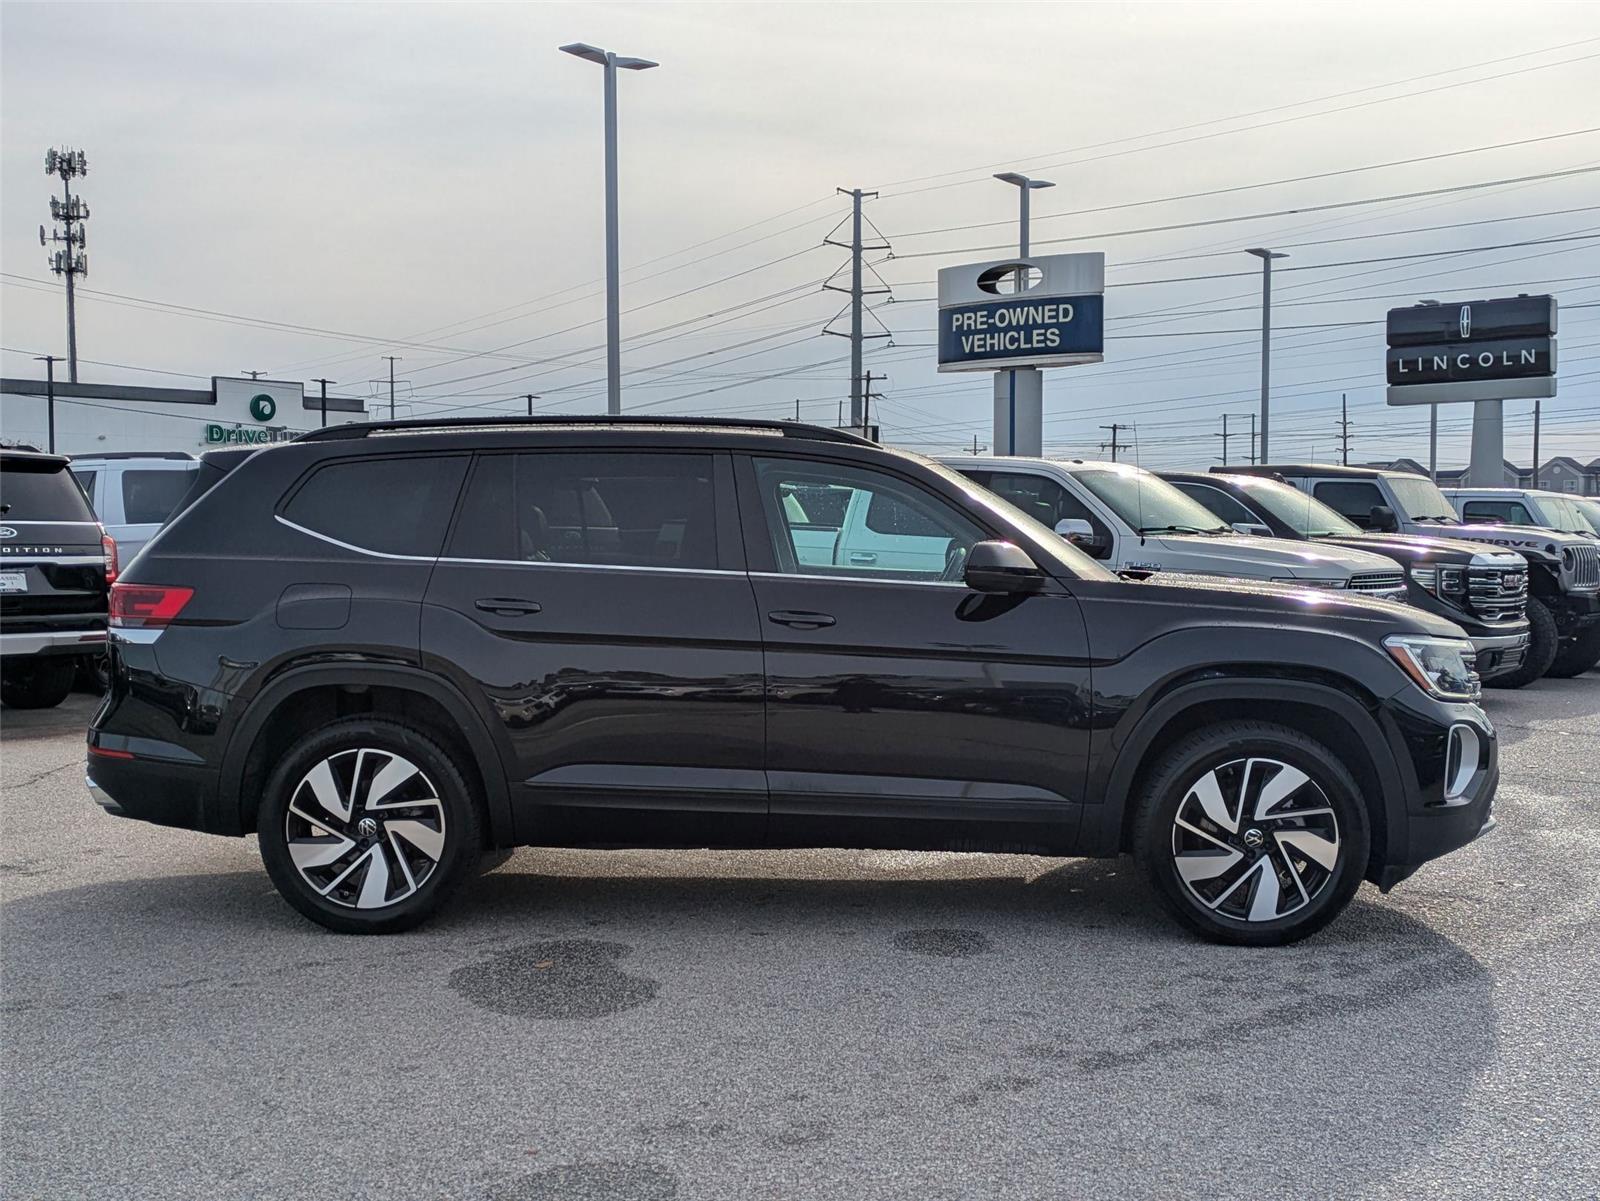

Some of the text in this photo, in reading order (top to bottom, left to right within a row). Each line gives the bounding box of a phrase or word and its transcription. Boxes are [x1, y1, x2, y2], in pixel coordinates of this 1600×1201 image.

[952, 304, 1074, 332] PRE-OWNED
[962, 328, 1060, 353] VEHICLES
[1399, 349, 1536, 373] LINCOLN
